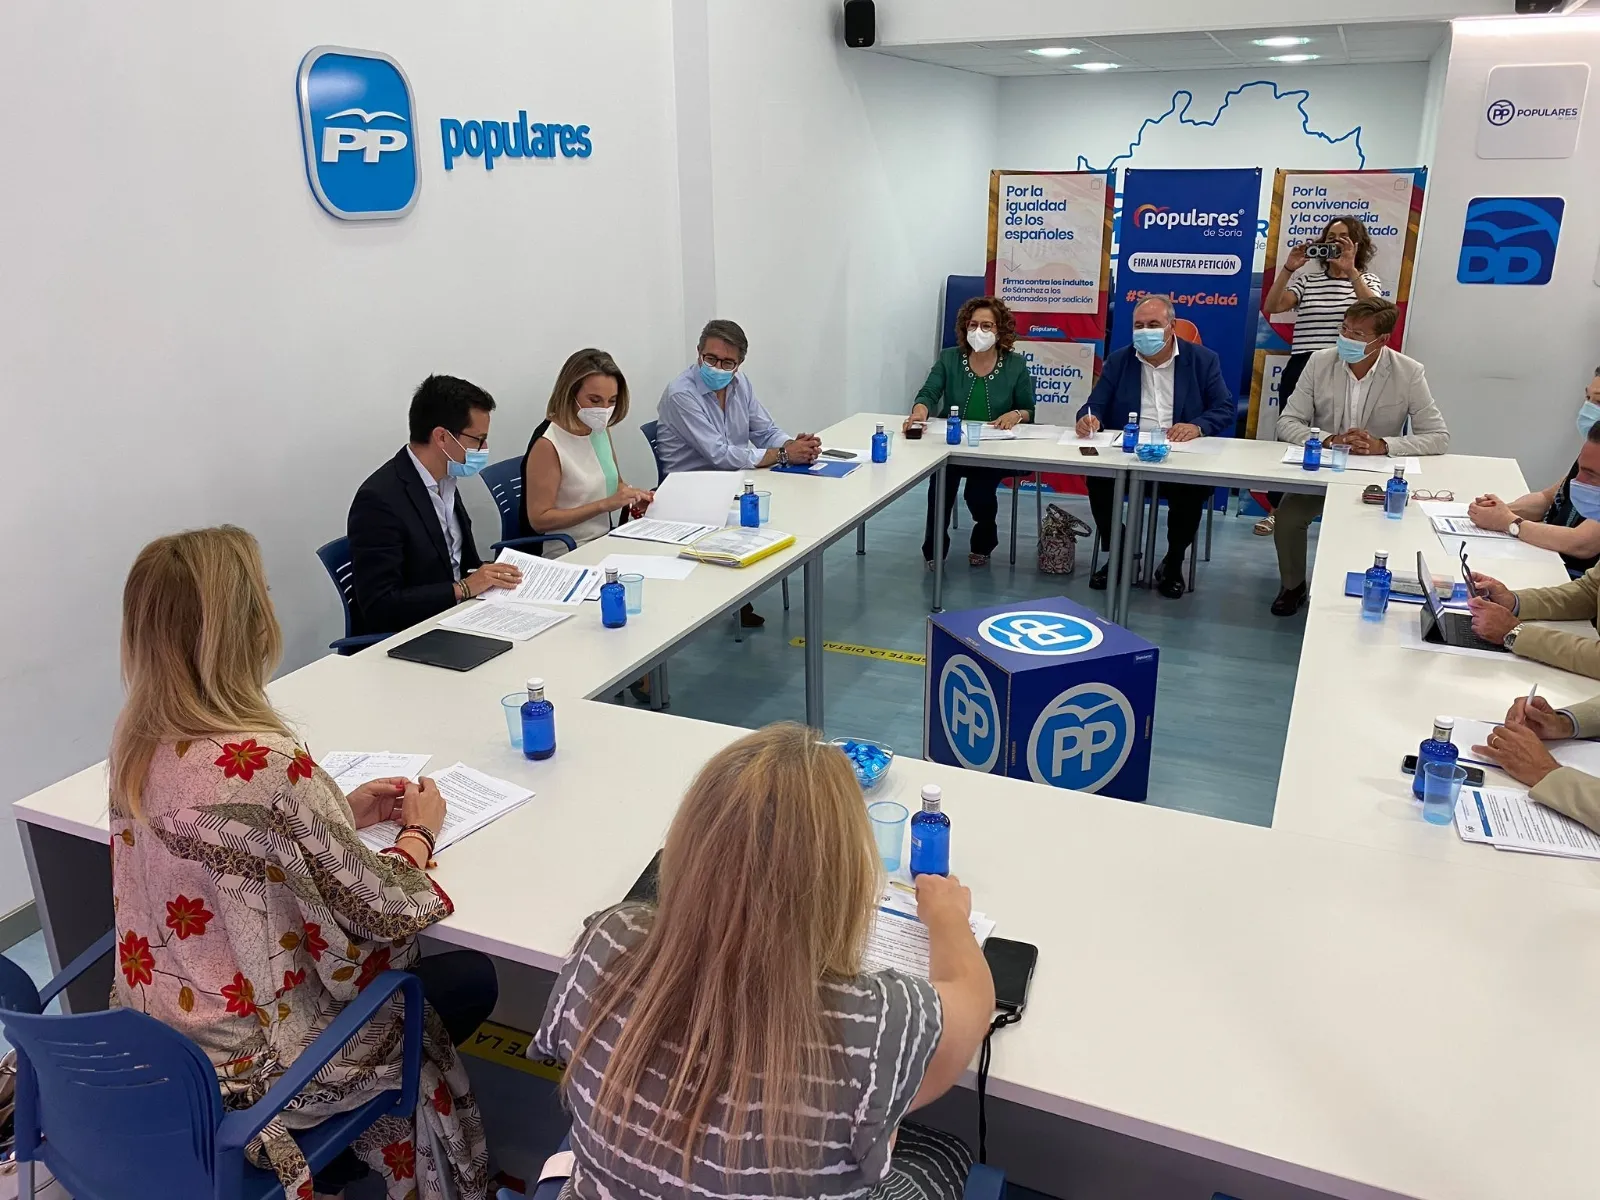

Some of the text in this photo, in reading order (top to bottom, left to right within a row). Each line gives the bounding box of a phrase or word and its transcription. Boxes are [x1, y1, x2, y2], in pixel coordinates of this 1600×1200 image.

[1517, 108, 1578, 117] POPULARES
[321, 109, 592, 170] PP populares
[1006, 185, 1043, 197] Por la
[1292, 186, 1327, 197] Por la
[1006, 199, 1067, 215] igualdad
[1291, 198, 1370, 210] convivencia
[1005, 214, 1044, 226] de los
[1289, 214, 1298, 225] y
[1299, 212, 1311, 223] la
[1005, 228, 1075, 243] españoles
[1203, 228, 1243, 237] de Soria
[1288, 225, 1399, 236] dentr tado
[1133, 258, 1236, 270] FIRMA NUESTRA PETICIÓN
[1012, 286, 1043, 294] Sánchez
[1063, 296, 1093, 304] sedición
[1063, 381, 1072, 394] y
[1035, 392, 1069, 404] paña
[952, 686, 989, 748] PP
[1051, 720, 1117, 778] PP
[475, 1032, 503, 1049] LA
